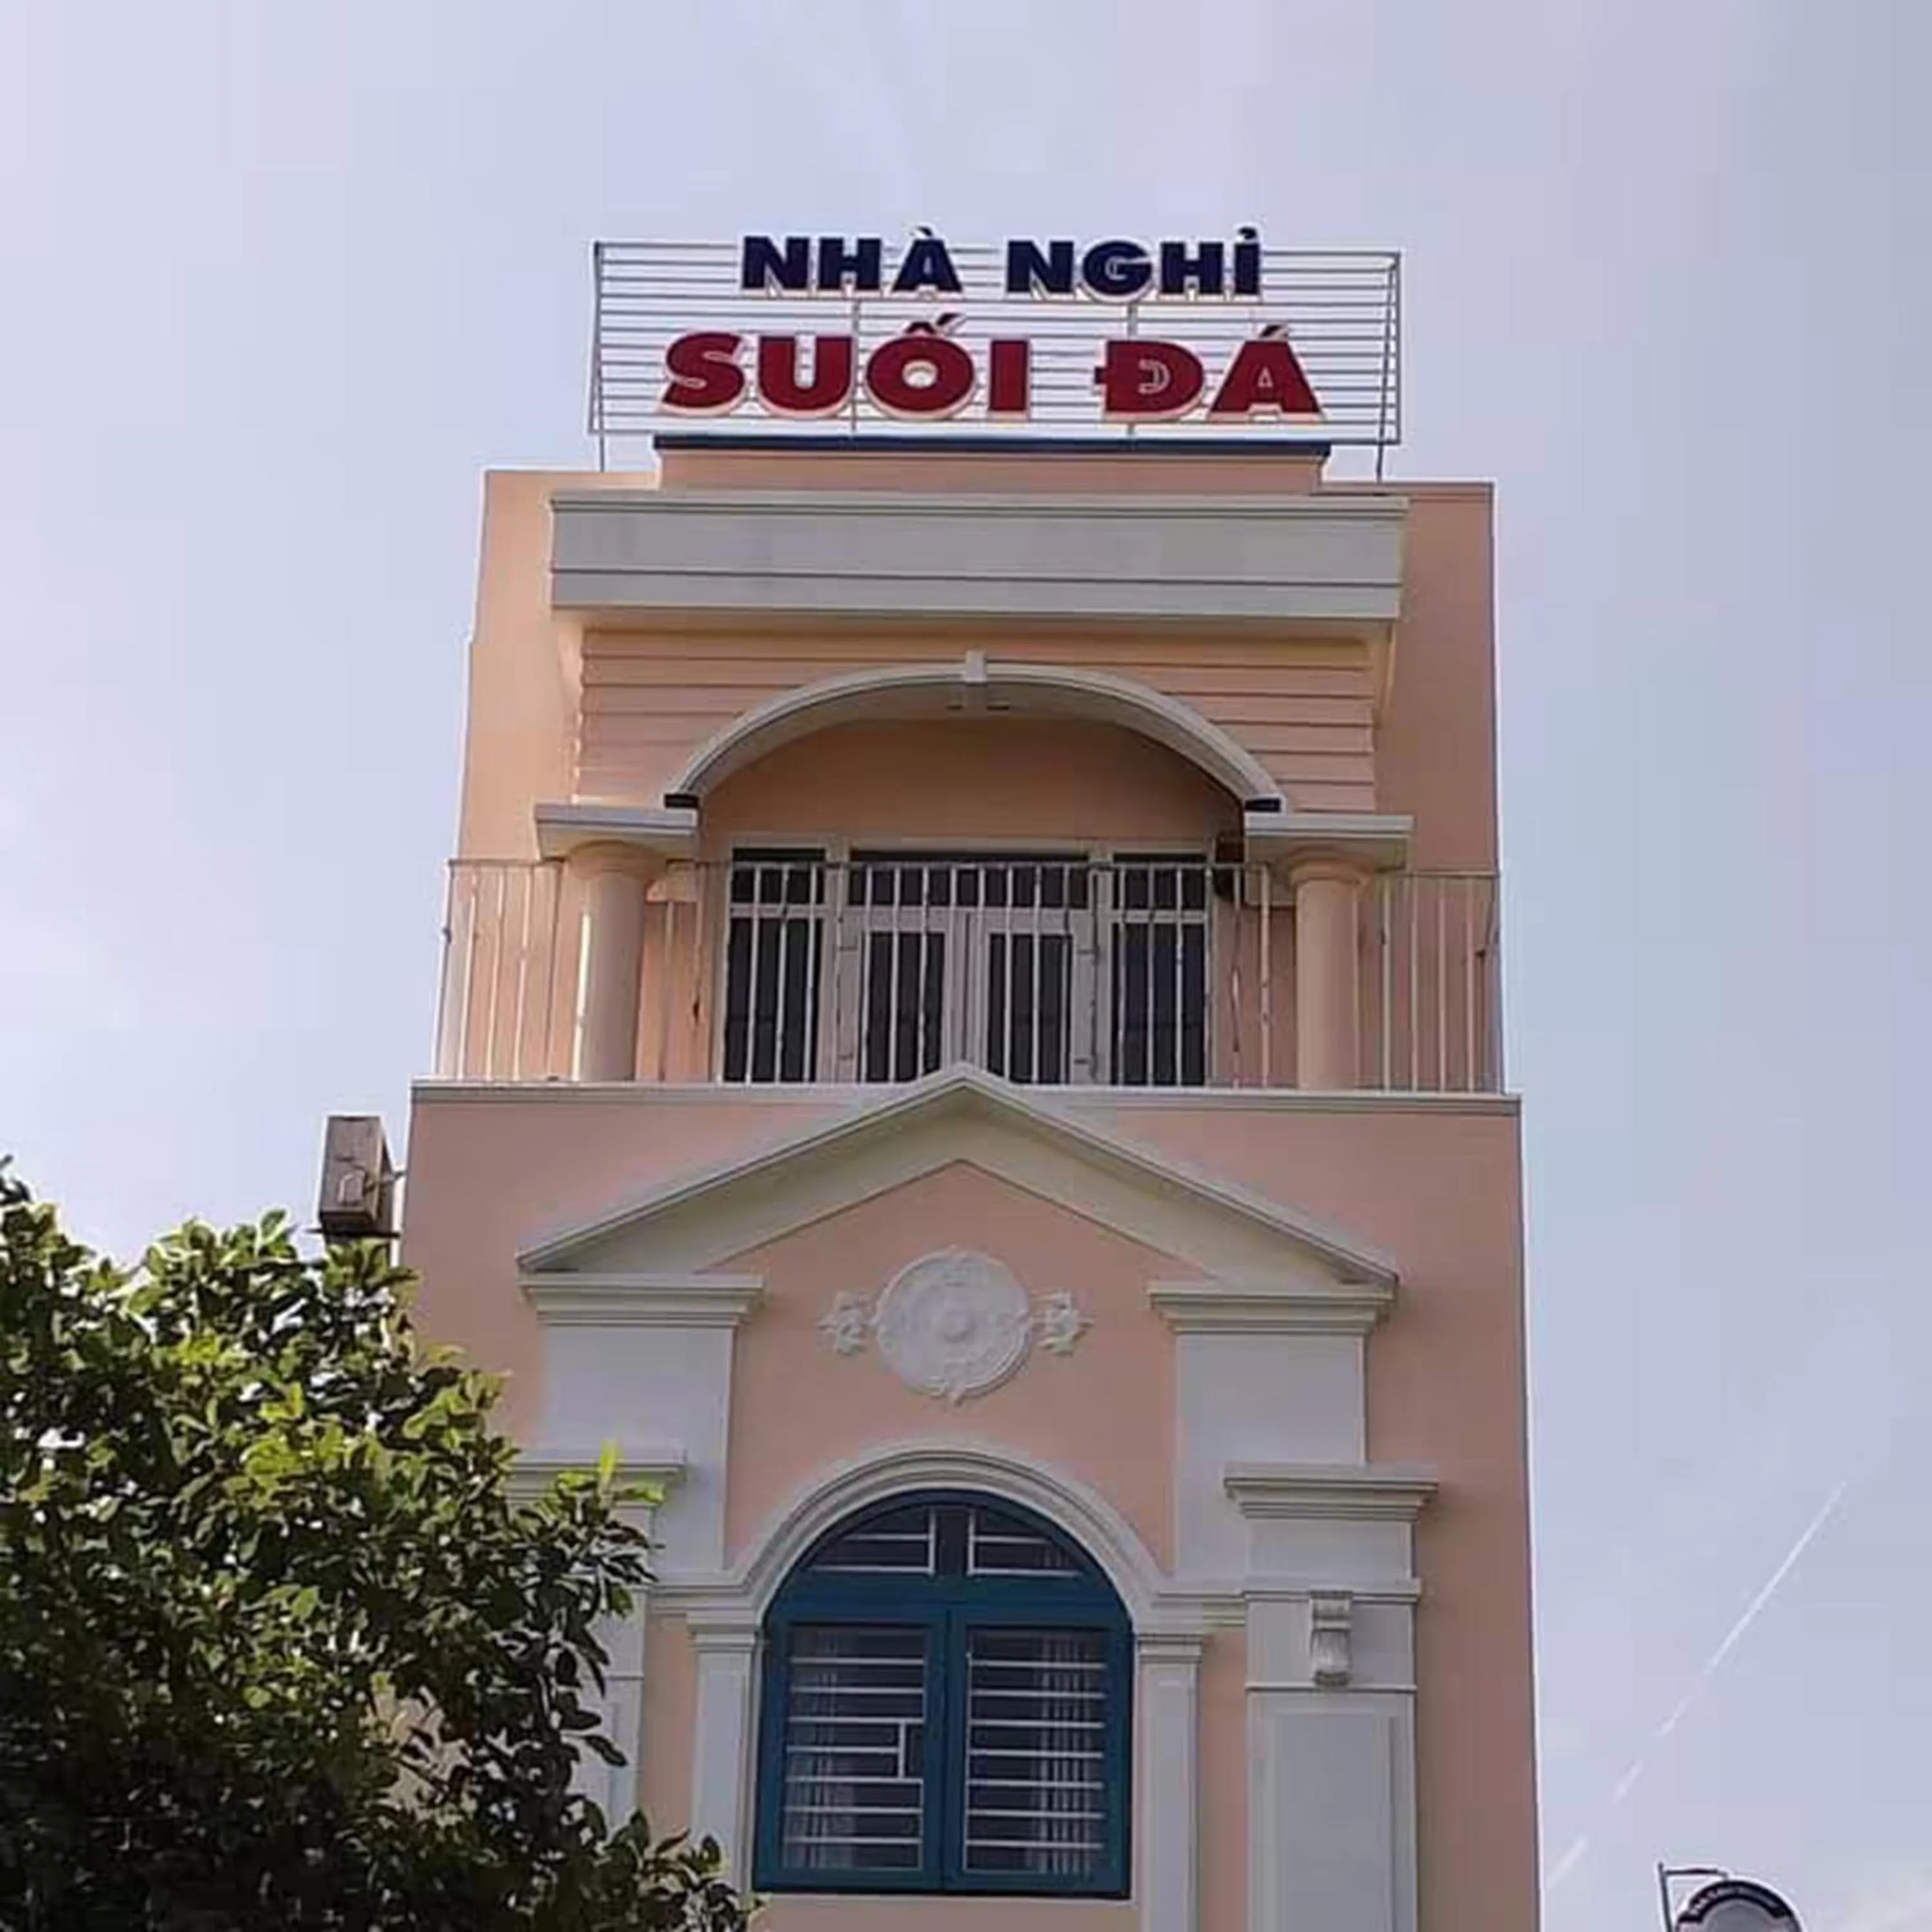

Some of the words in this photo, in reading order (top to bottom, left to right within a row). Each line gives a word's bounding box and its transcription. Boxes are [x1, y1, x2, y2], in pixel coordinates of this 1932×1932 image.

[741, 225, 963, 294] NHÀ
[1005, 225, 1261, 298] NGHỈ
[660, 312, 1030, 415] SUỐI
[1094, 324, 1321, 416] ĐÁ
